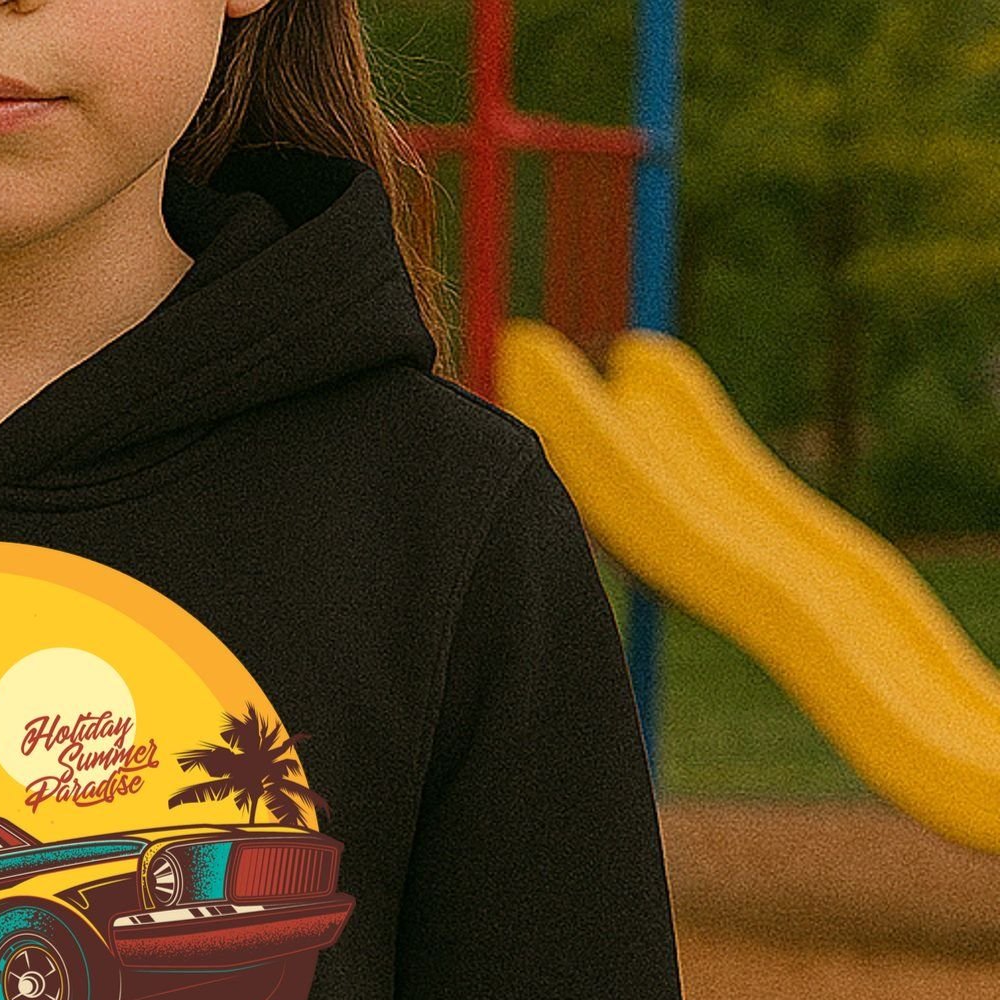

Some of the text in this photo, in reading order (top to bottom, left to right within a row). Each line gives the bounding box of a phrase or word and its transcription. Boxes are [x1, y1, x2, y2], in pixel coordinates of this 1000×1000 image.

[21, 711, 133, 756] Holiday
[58, 738, 159, 783] Summer
[25, 770, 144, 814] Paradise
